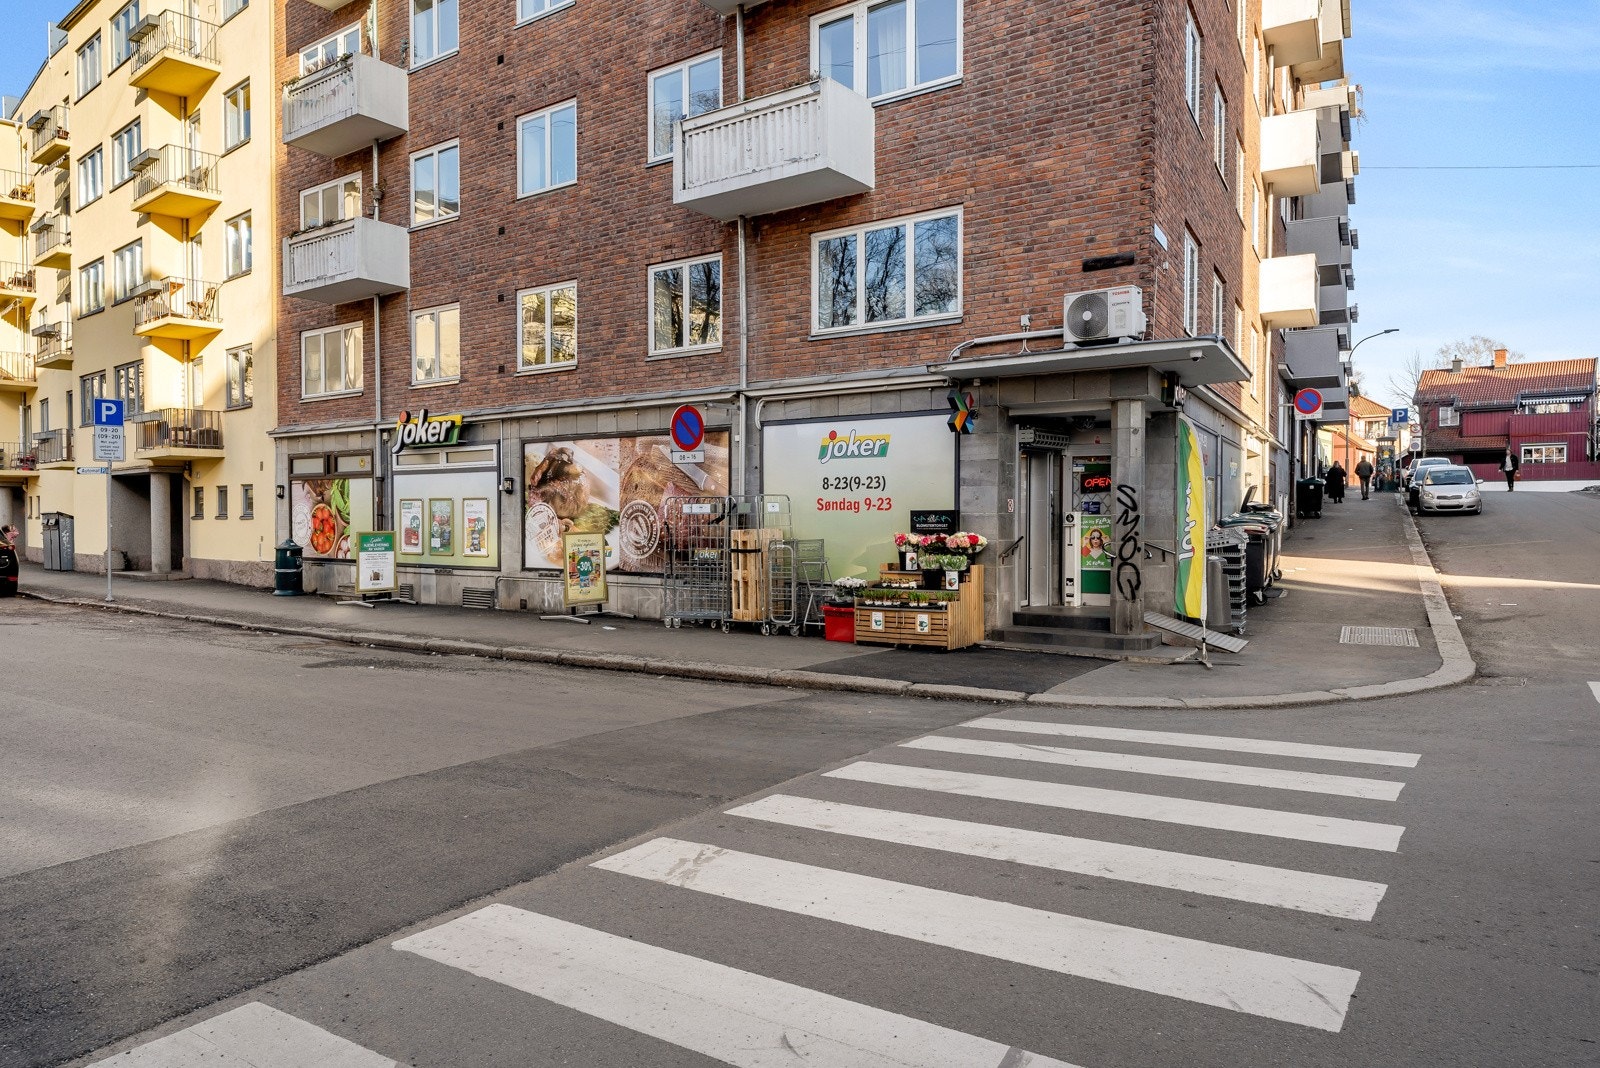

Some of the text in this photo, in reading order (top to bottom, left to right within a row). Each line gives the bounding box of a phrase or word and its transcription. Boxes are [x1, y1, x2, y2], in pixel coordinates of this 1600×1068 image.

[101, 402, 117, 423] P
[1396, 410, 1405, 422] P
[391, 408, 452, 454] joker
[820, 429, 887, 464] joker
[816, 497, 893, 514] Søndag 9-23
[577, 561, 592, 571] -30%
